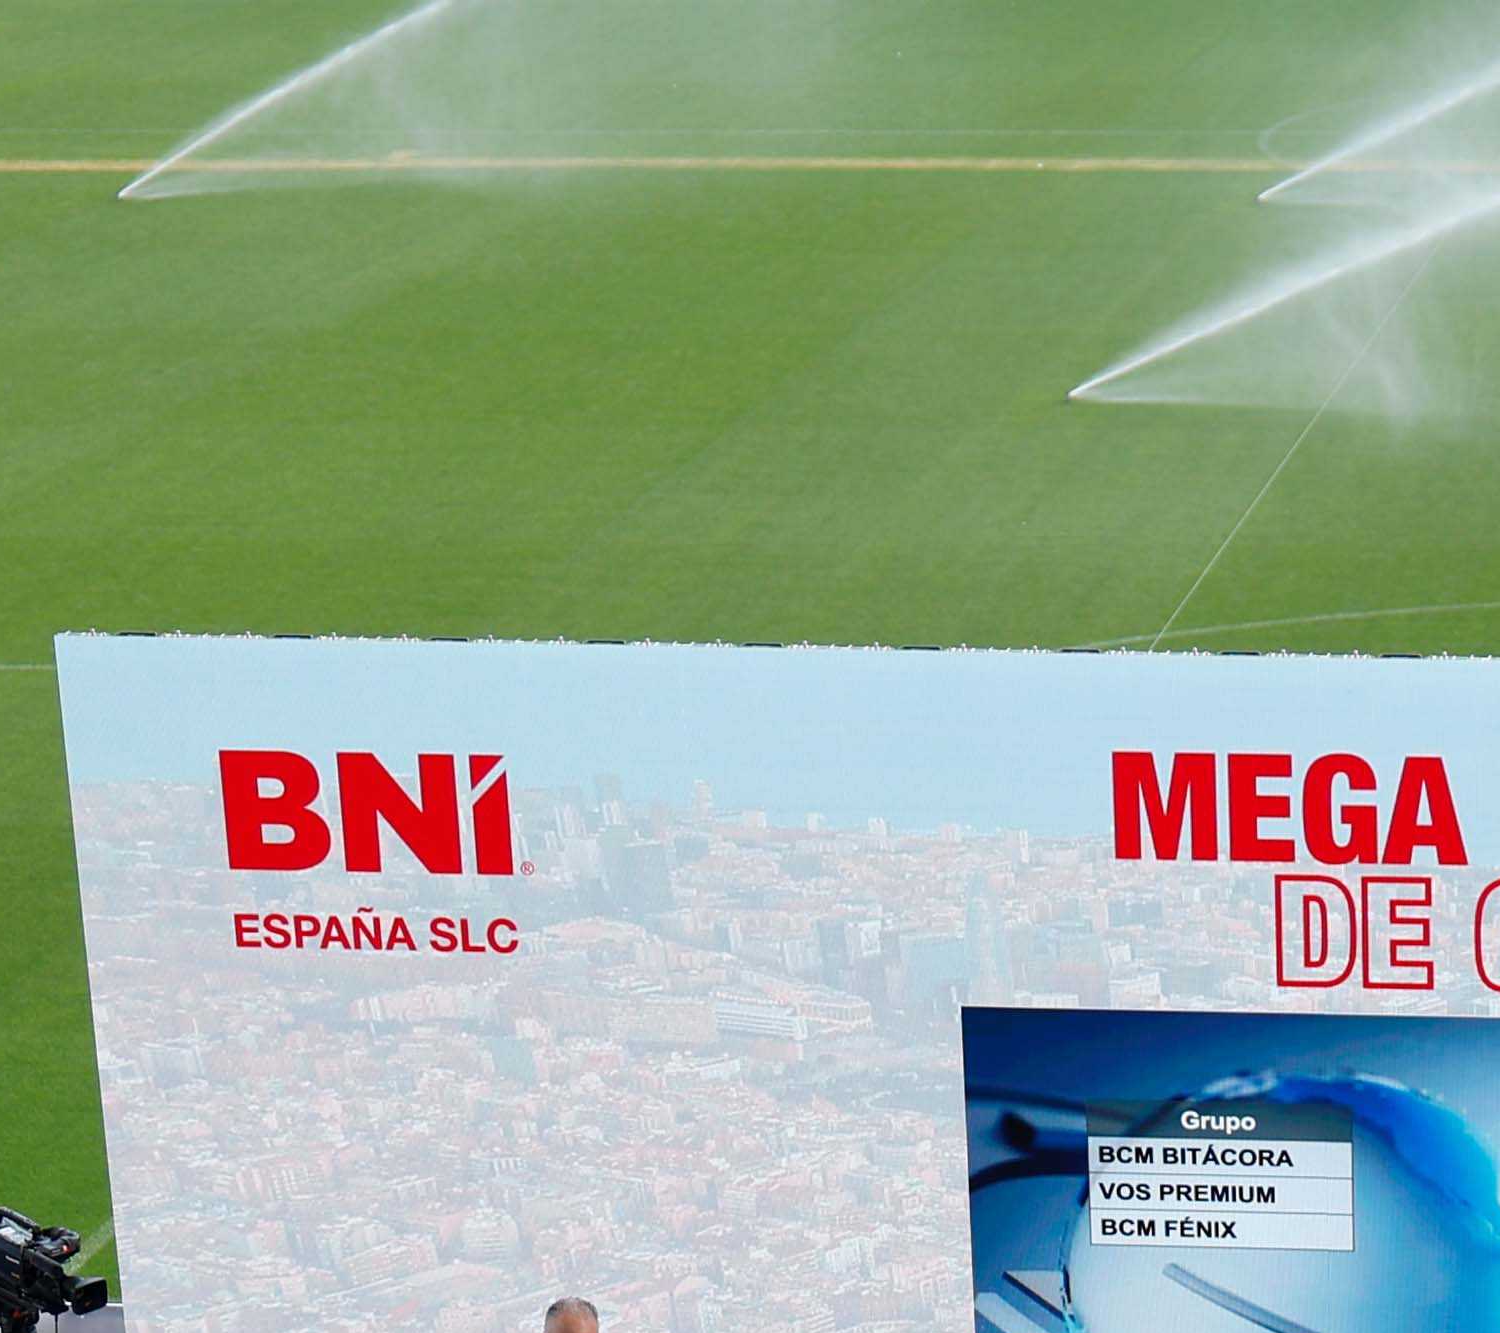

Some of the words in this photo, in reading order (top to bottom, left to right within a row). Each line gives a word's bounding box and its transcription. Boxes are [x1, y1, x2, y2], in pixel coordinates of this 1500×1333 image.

[1112, 751, 1468, 865] MEGA
[234, 907, 417, 951] ESPAÑA
[429, 917, 519, 954] SLC
[1274, 874, 1434, 990] DE
[1180, 1110, 1256, 1134] Grupo
[1099, 1146, 1154, 1165] BCM
[1162, 1144, 1294, 1167] BITÁCORA
[1099, 1183, 1150, 1201] VOS
[1159, 1184, 1276, 1203] PREMIUM
[1101, 1219, 1156, 1237] BCM
[1165, 1216, 1237, 1239] FÉNIX
